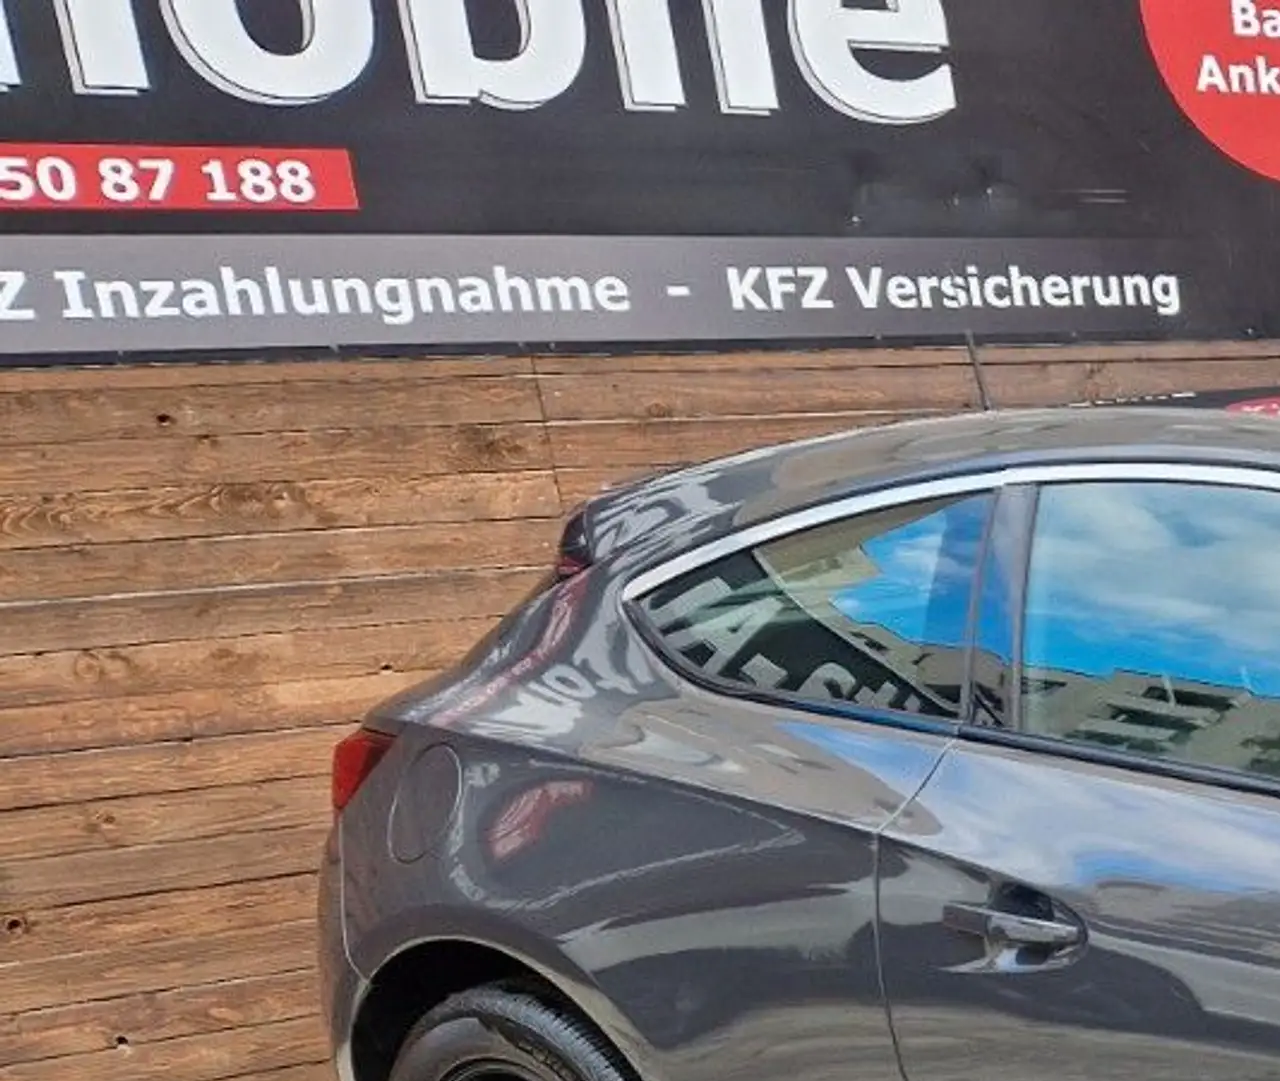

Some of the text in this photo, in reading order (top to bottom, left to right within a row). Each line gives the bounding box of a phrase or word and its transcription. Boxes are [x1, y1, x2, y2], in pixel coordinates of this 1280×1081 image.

[98, 158, 174, 201] 87
[202, 159, 316, 203] 188
[54, 265, 631, 325] Inzahlungnahme
[667, 285, 690, 297] -
[726, 265, 834, 312] KFZ
[845, 264, 1181, 316] Versicherung
